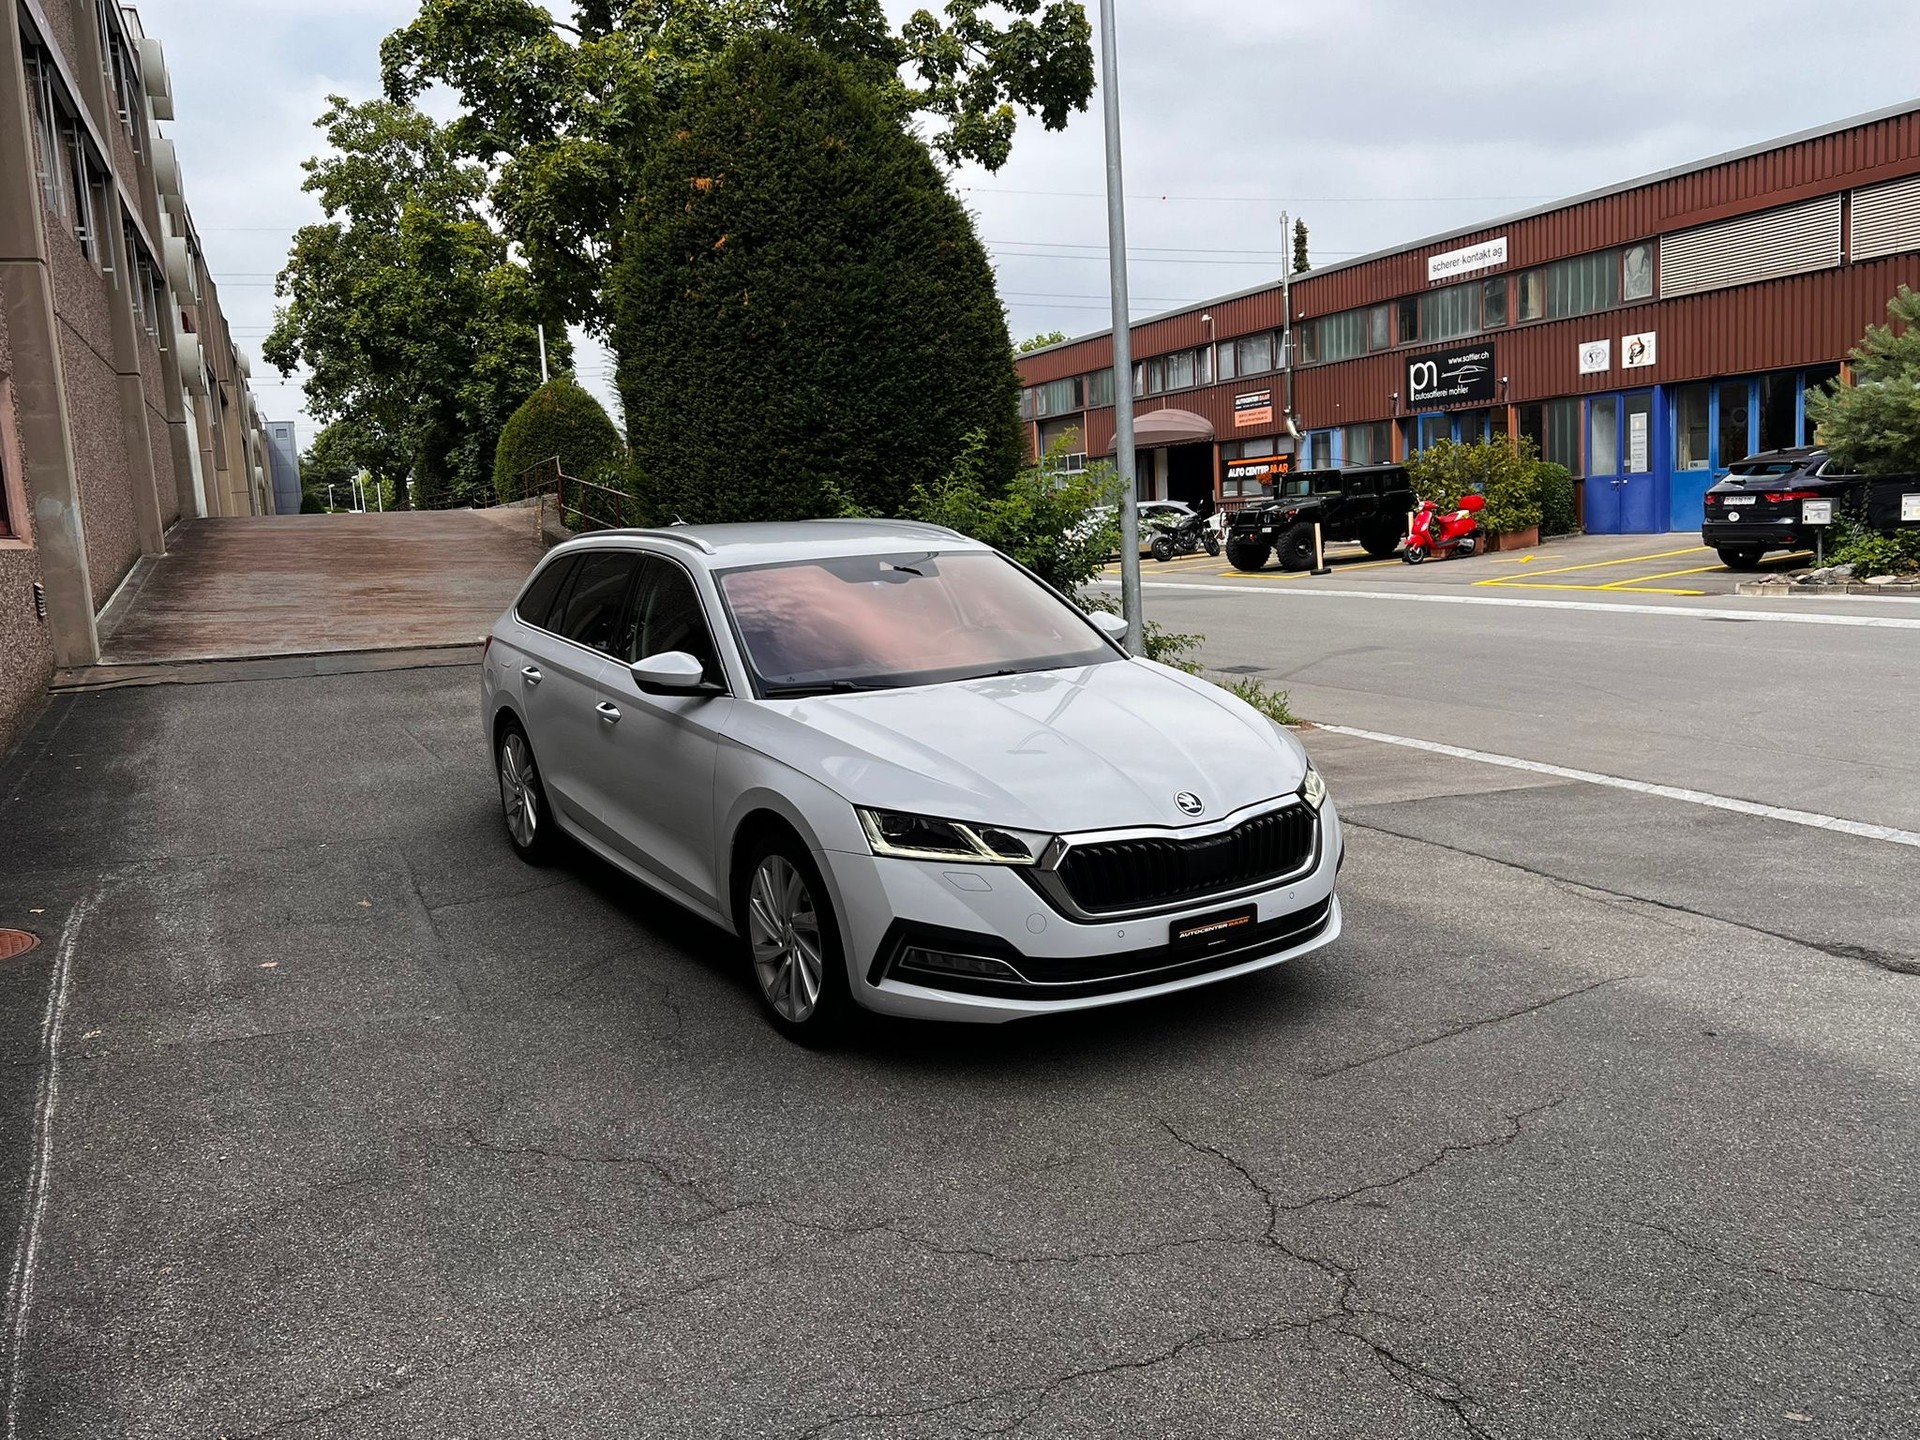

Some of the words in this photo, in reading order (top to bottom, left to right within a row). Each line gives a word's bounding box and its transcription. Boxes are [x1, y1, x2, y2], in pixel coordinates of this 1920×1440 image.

[1432, 258, 1460, 272] scherer
[1462, 248, 1491, 265] kontakt
[1492, 247, 1503, 257] ag
[1448, 384, 1469, 396] mohler
[1228, 467, 1245, 478] AUTO
[1245, 465, 1270, 477] CENTER
[1179, 923, 1228, 938] AUTOCENTER
[1228, 918, 1249, 927] BAAR
